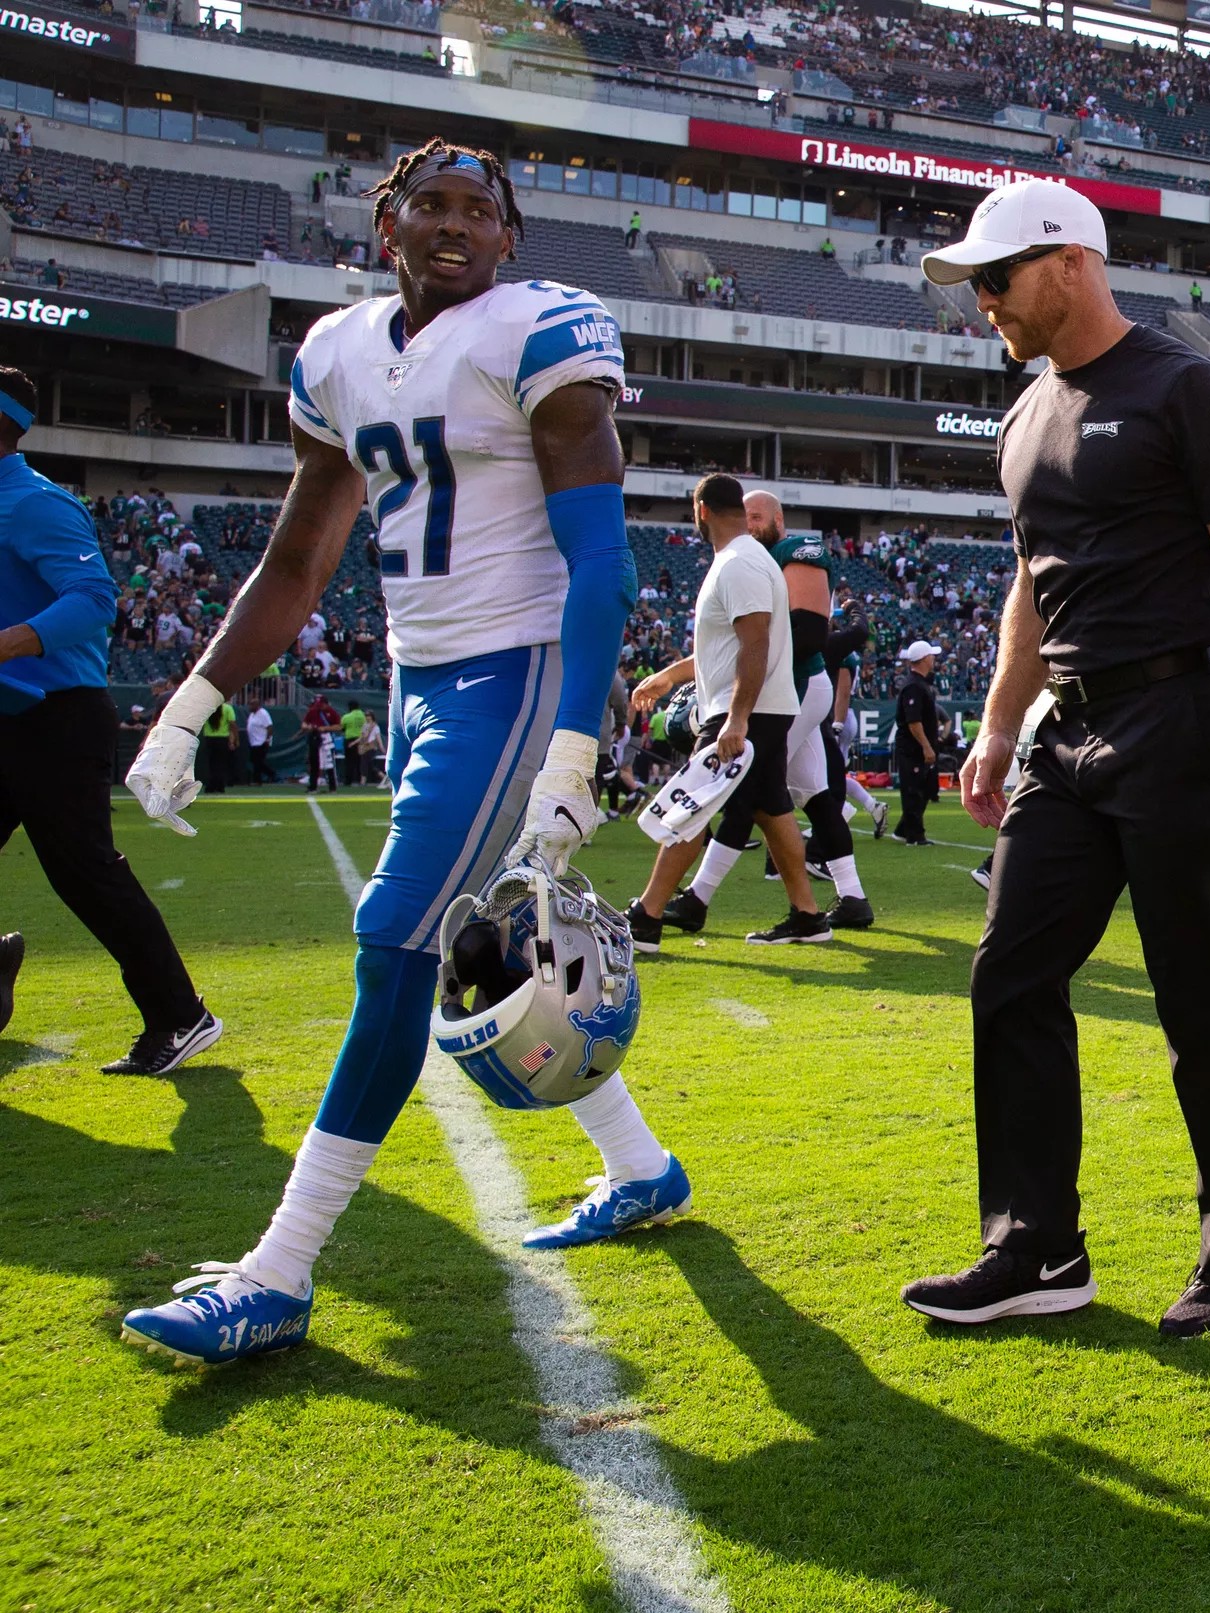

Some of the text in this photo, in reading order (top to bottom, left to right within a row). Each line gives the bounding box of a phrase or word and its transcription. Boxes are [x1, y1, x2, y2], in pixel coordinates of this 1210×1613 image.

[826, 142, 911, 177] Lincoln
[913, 155, 1011, 189] Financial
[570, 321, 616, 348] WCF
[621, 387, 644, 403] BY
[1081, 420, 1121, 437] EAGLES
[355, 415, 457, 578] 21
[435, 1018, 501, 1054] DETR
[218, 1316, 249, 1352] 21
